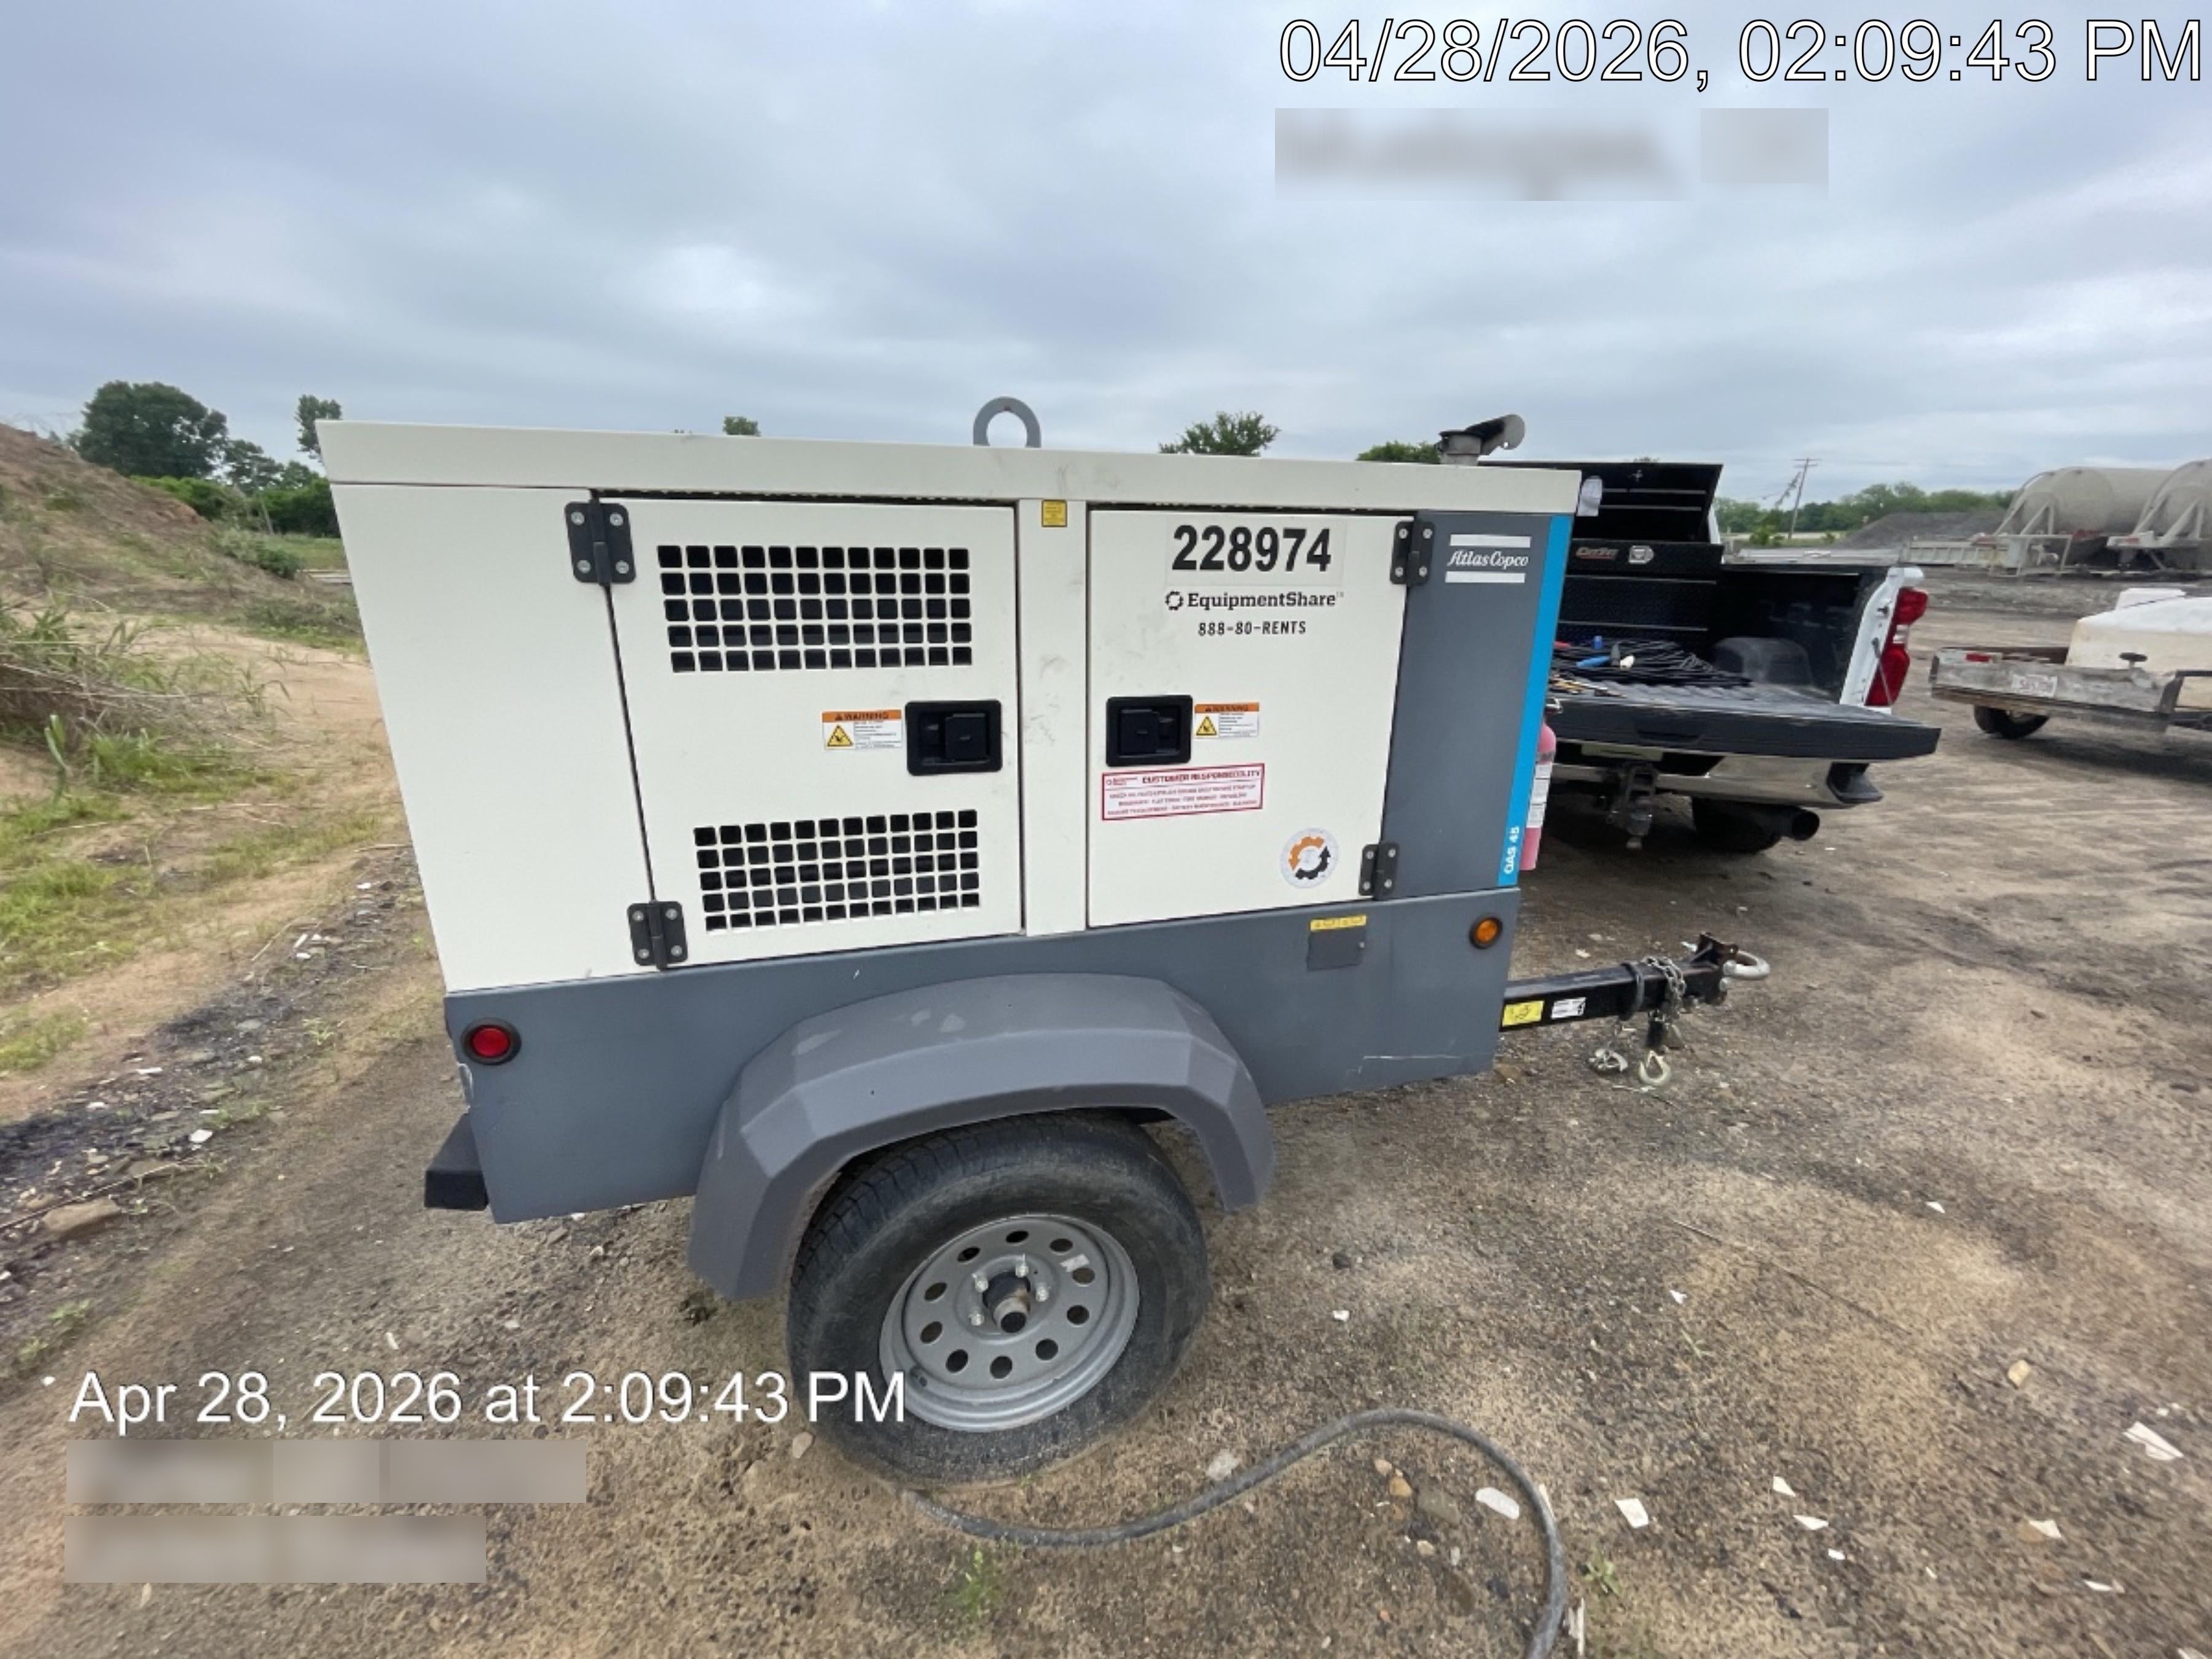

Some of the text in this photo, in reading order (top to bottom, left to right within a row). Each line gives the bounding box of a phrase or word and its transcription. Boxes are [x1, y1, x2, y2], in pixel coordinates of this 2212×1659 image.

[1172, 525, 1332, 571] 228974
[1446, 550, 1529, 570] Atlas Copco
[1187, 592, 1336, 610] EquipmentShare
[1198, 621, 1306, 636] 888-80-RENTS
